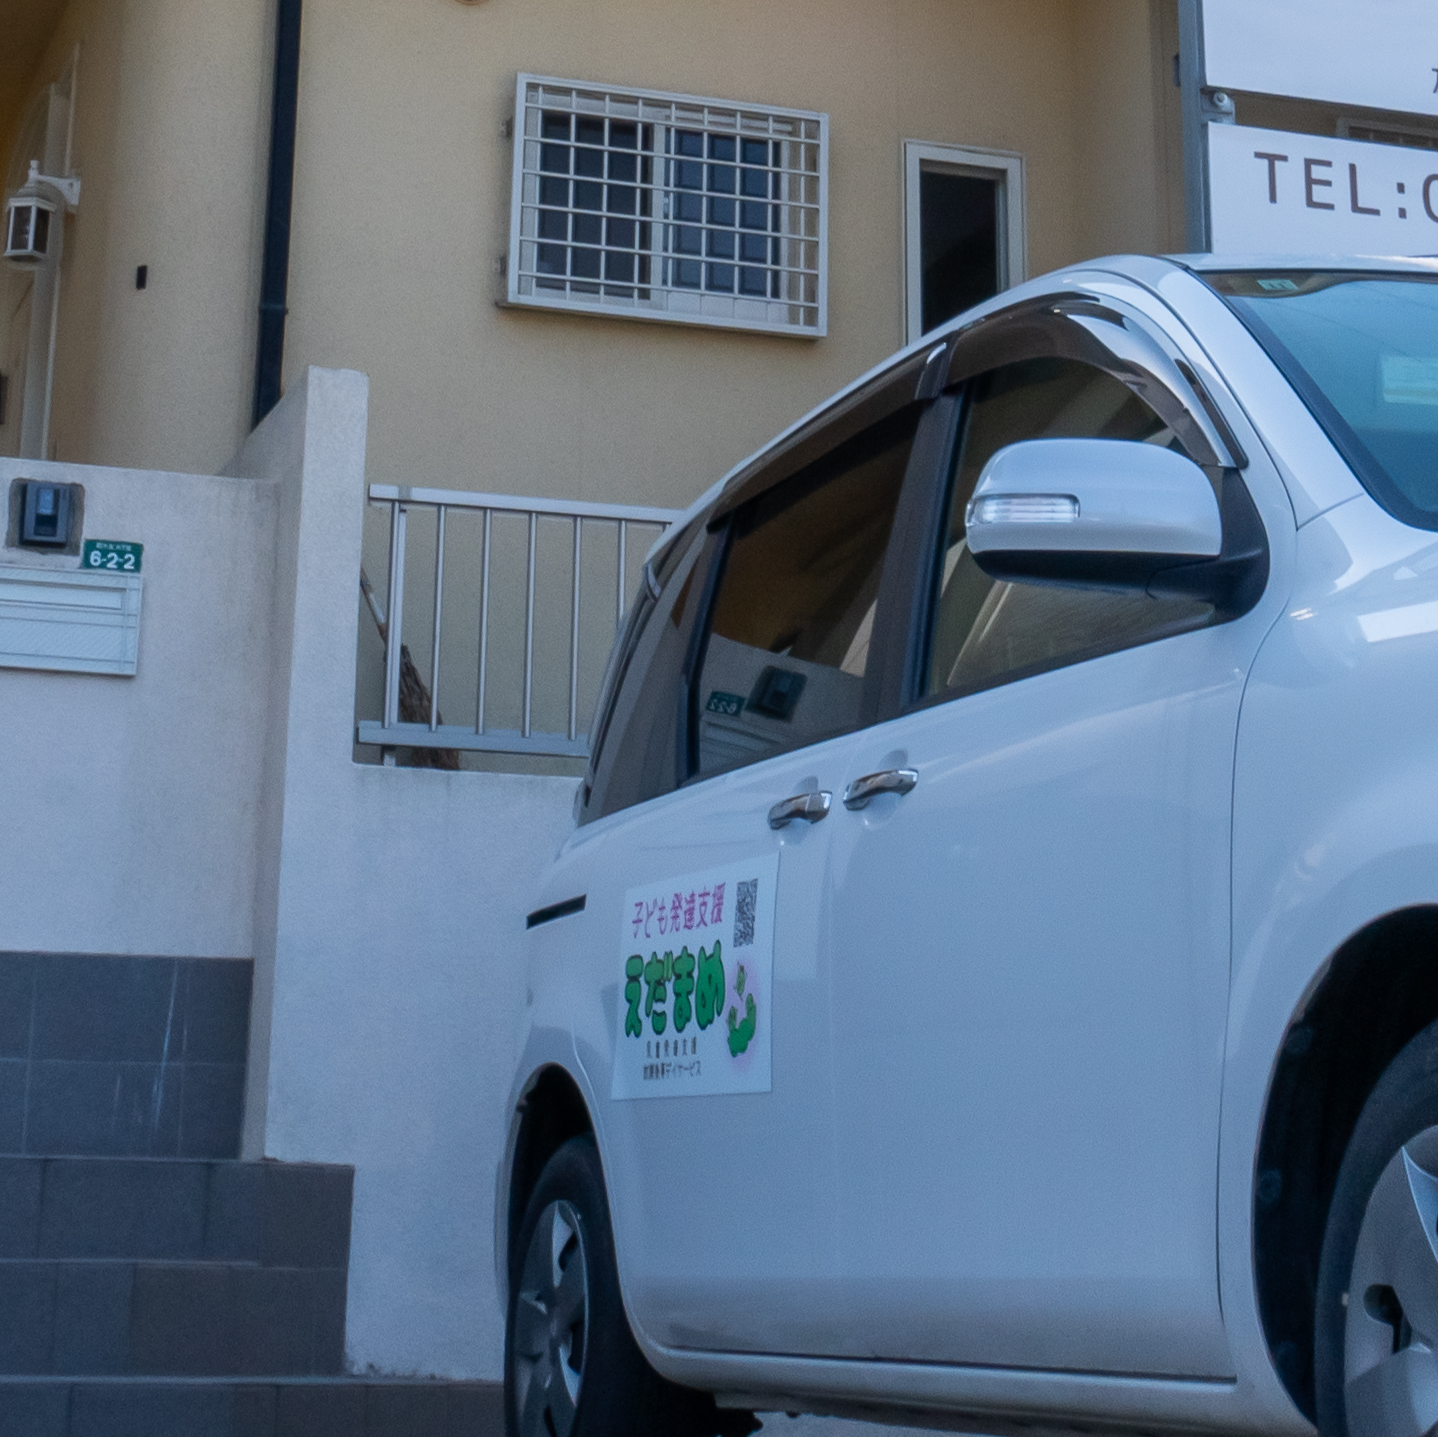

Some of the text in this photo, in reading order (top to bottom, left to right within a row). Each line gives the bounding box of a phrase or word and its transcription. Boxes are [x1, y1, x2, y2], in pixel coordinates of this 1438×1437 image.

[90, 550, 135, 569] 6-2-2
[632, 882, 726, 939] 子ども発達支援
[625, 939, 725, 1038] えだまめ
